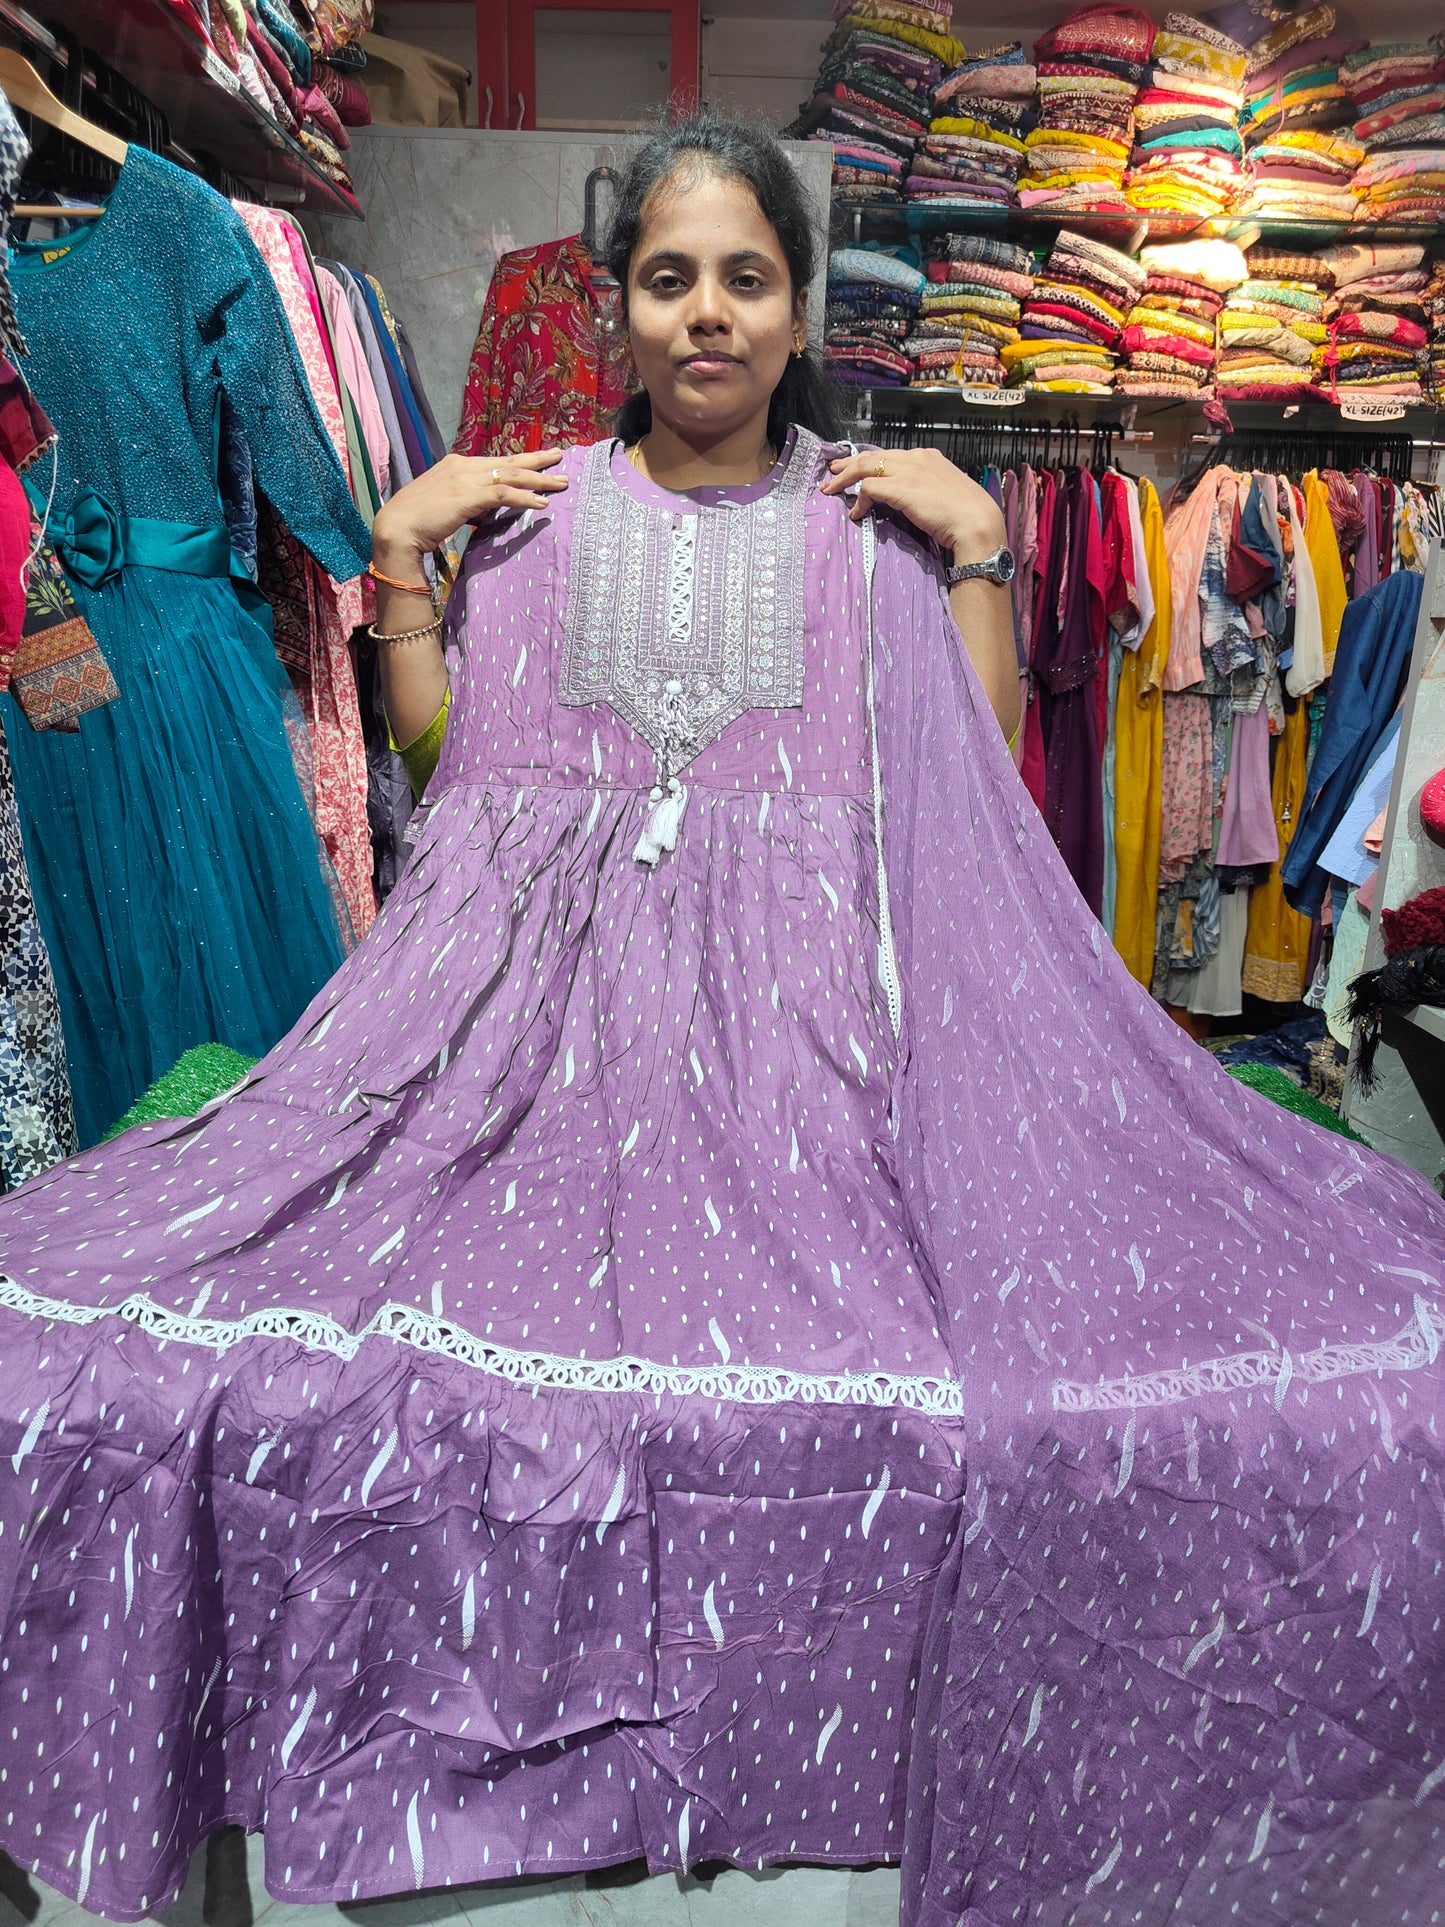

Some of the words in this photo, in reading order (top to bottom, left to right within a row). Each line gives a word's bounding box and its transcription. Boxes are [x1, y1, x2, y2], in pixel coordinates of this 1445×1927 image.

[982, 391, 1024, 402] SIZE(42)
[1345, 405, 1357, 415] XL
[1360, 404, 1403, 416] SIZE(42)
